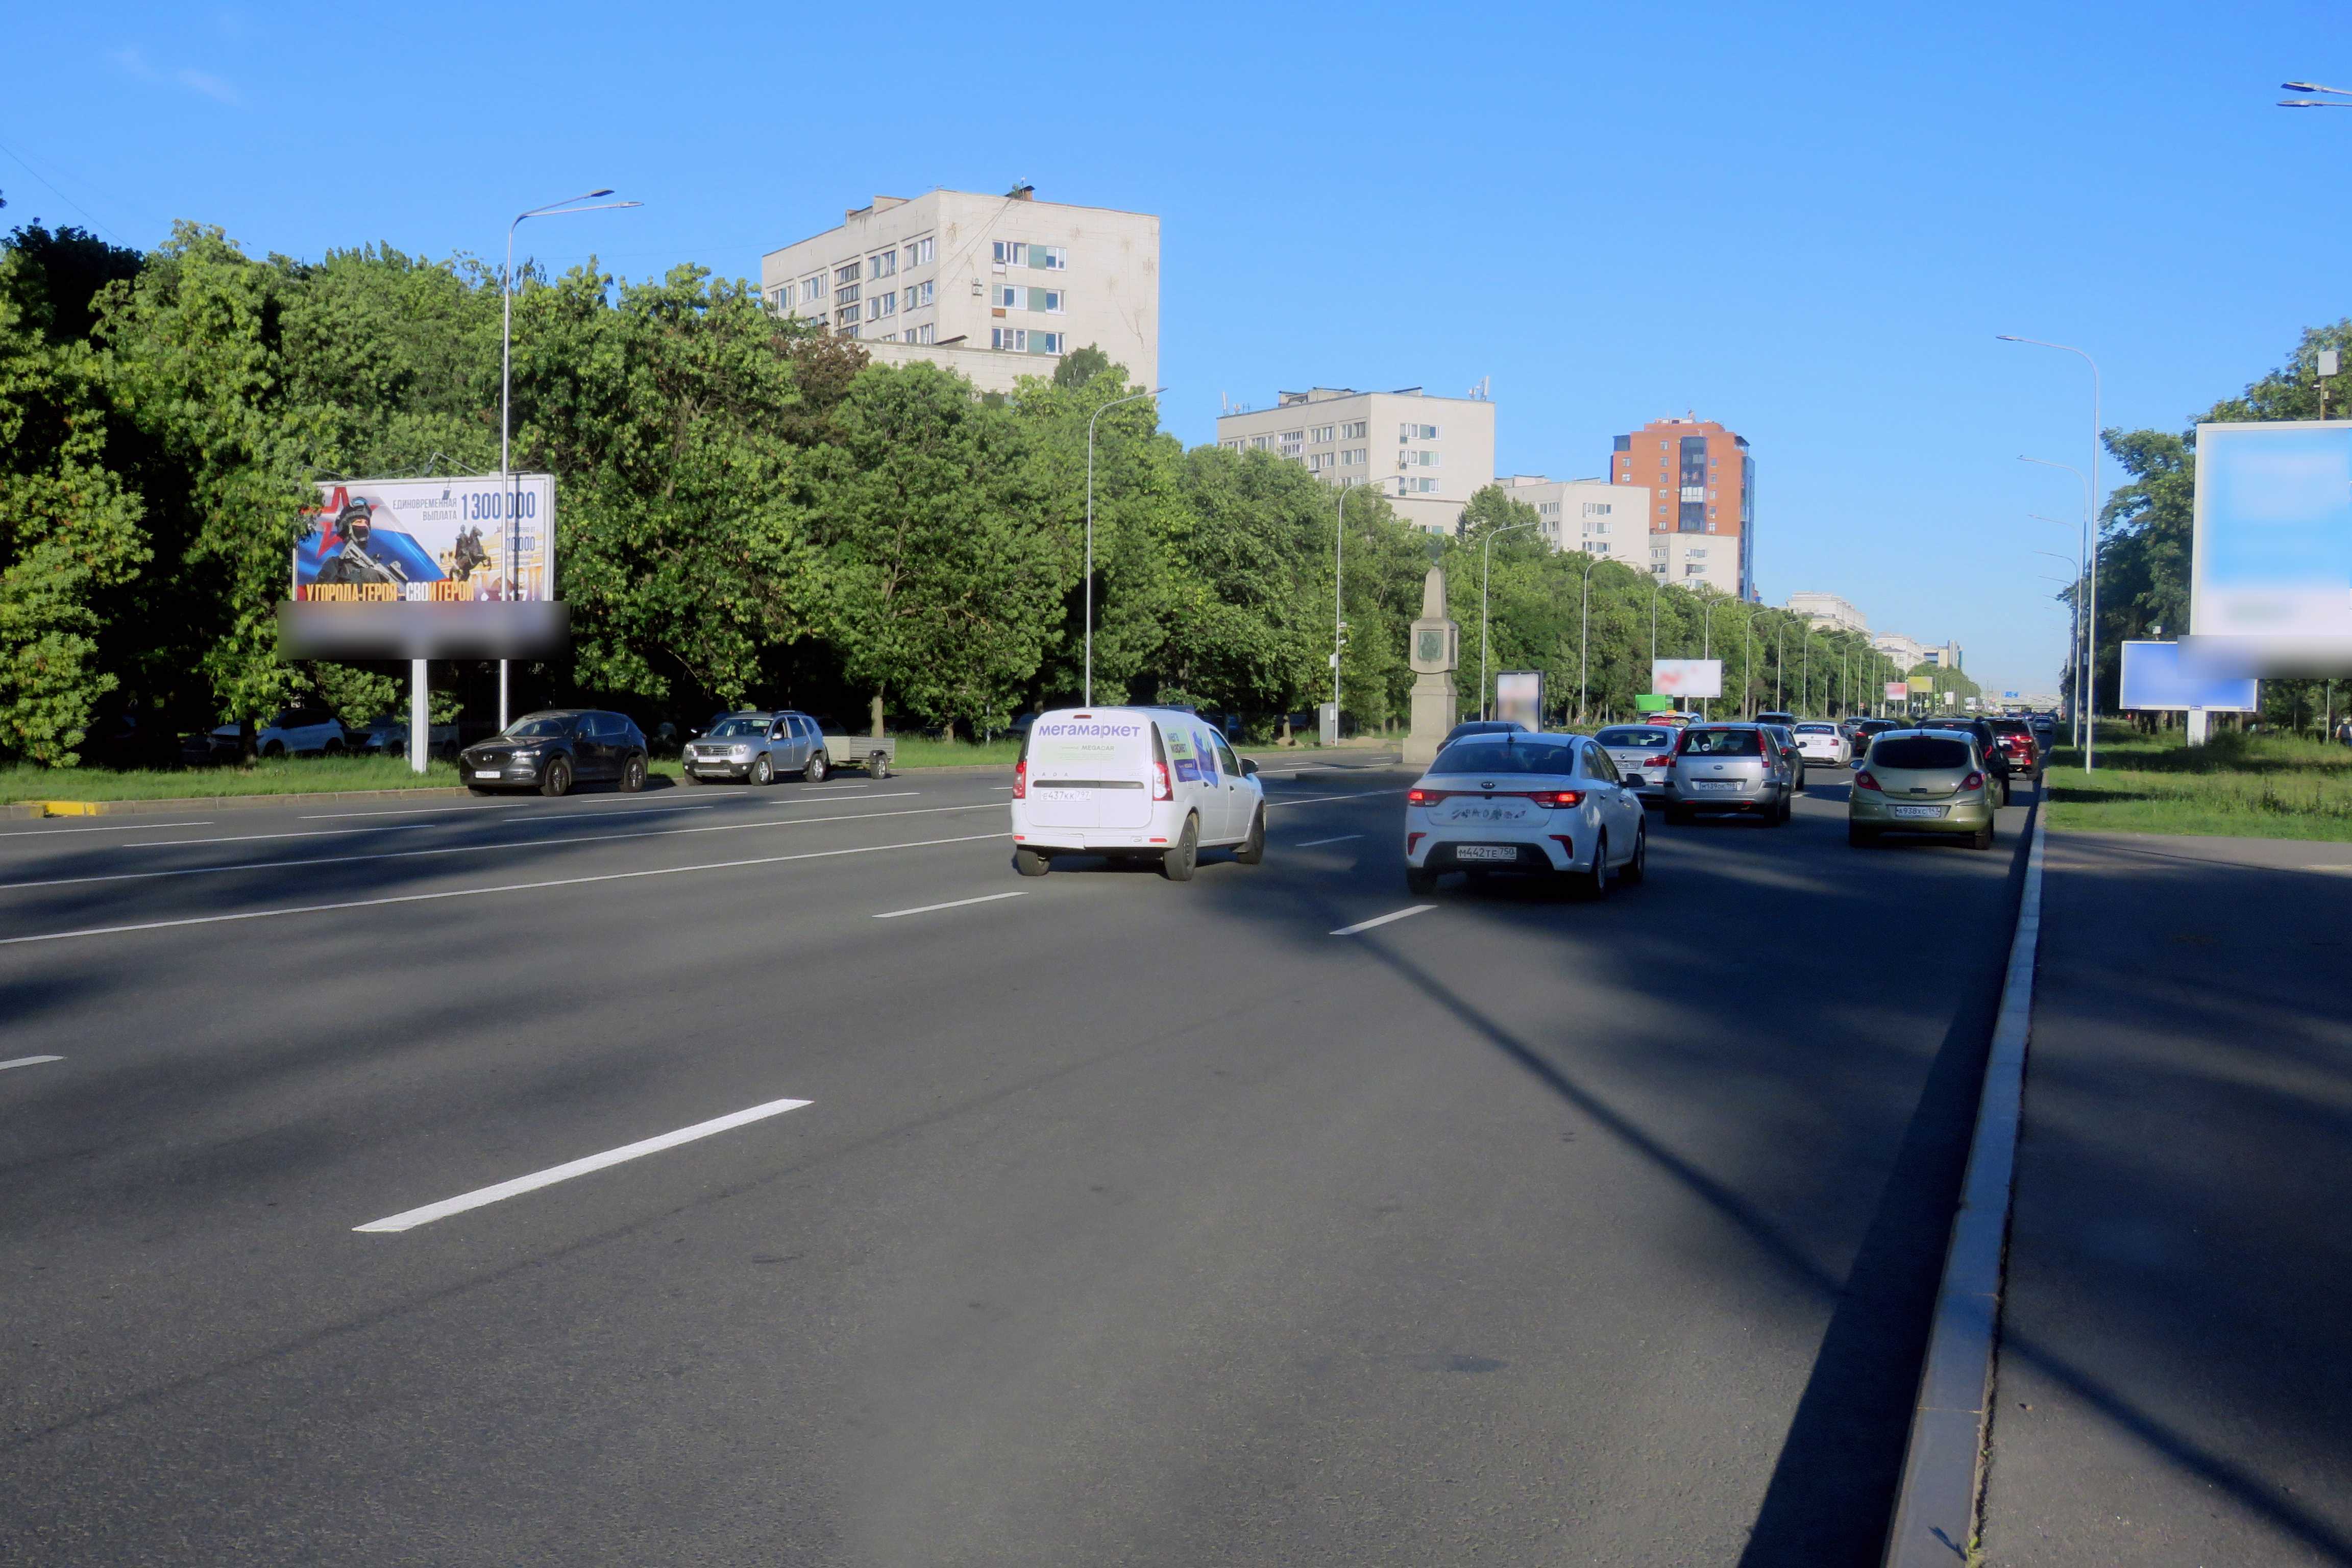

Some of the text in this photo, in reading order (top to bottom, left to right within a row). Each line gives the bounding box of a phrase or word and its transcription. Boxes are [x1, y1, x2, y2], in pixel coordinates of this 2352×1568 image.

[393, 498, 457, 510] ЕДИНОВРЕМЕННАЯ
[423, 511, 457, 521] ВЫПЛАТА
[1038, 724, 1141, 739] мегамаркет
